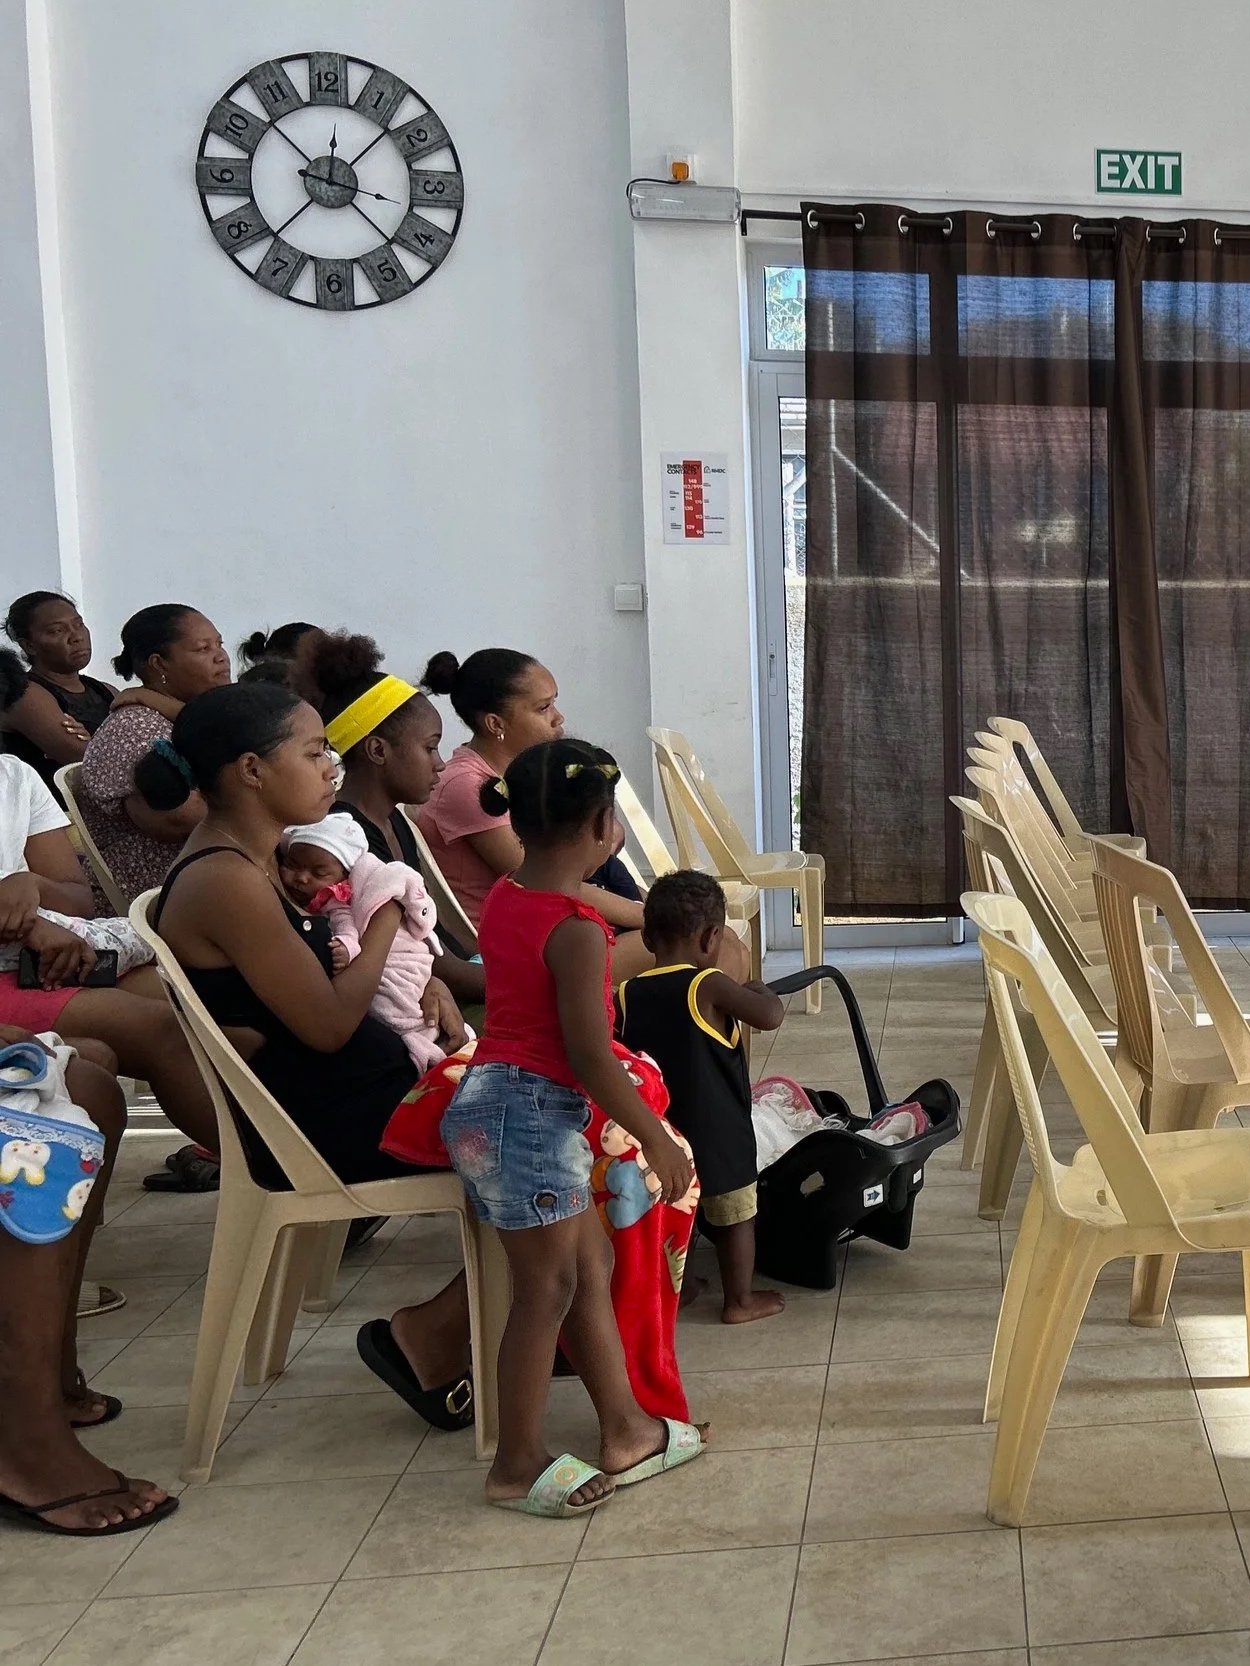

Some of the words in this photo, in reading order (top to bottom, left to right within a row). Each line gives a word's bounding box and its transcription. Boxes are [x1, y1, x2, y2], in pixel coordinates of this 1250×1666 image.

[315, 71, 339, 92] 12
[263, 80, 289, 103] 11
[371, 91, 385, 109] 1
[225, 113, 249, 138] 10
[406, 129, 428, 147] 2
[209, 168, 234, 184] 9
[1100, 153, 1179, 190] EXIT
[423, 179, 445, 195] 3
[227, 223, 252, 240] 8
[415, 232, 435, 247] 4
[271, 257, 289, 276] 7
[377, 260, 396, 282] 5
[326, 274, 343, 294] 6
